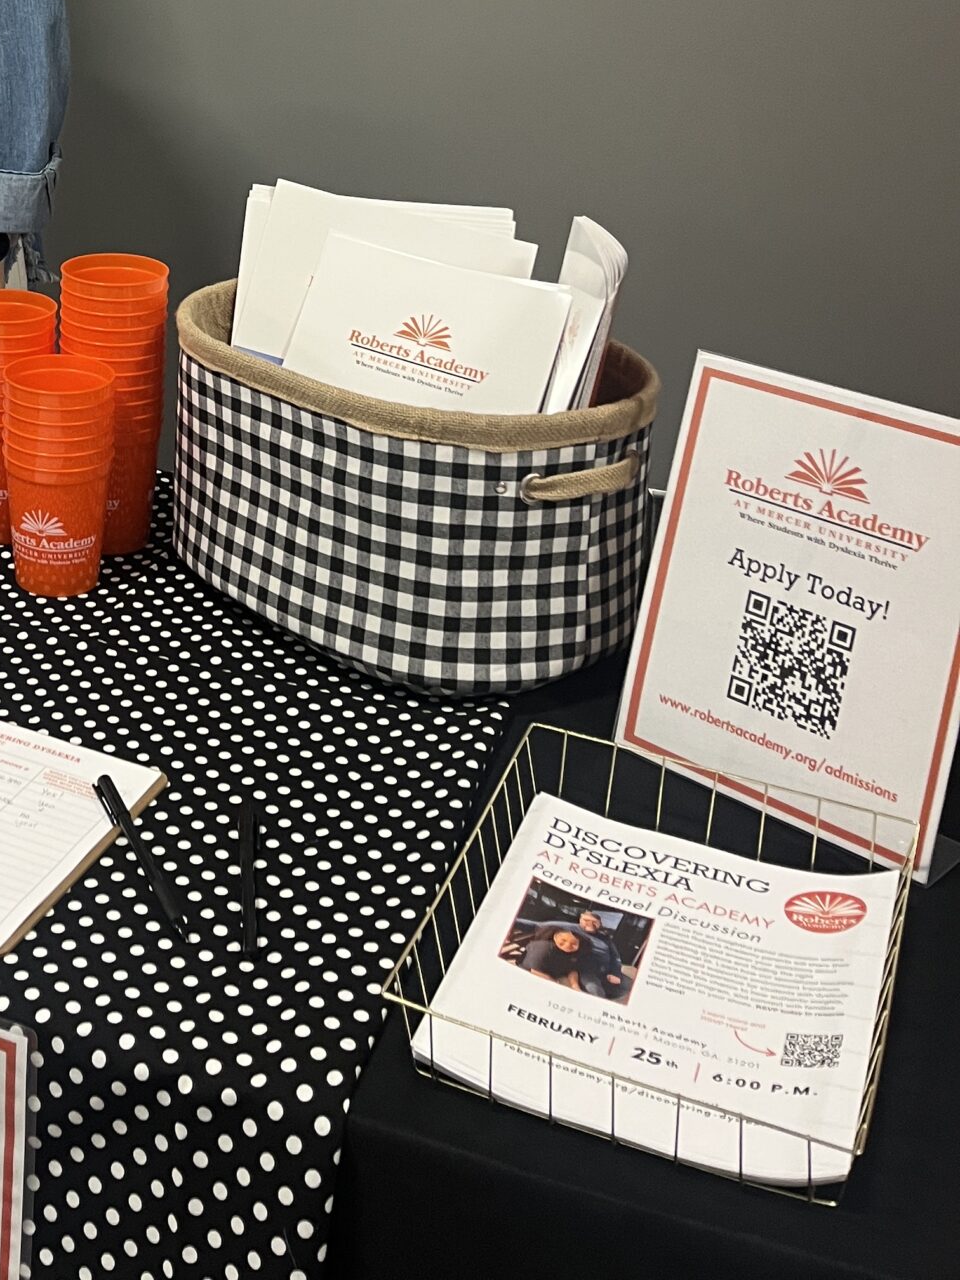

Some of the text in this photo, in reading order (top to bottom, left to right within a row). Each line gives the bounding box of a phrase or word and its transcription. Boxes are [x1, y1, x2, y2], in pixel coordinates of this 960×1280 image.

[348, 329, 490, 384] Roberts Academy
[352, 350, 473, 391] AT MERCER UNIVERSITY
[39, 534, 96, 550] Academy
[725, 469, 930, 553] Roberts Academy
[734, 499, 909, 563] AT MERCER UNIVERSITY
[739, 511, 898, 571] Where Students with Dyslexia Thrive
[728, 547, 890, 620] Apply Today!
[32, 742, 81, 764] DYSLEXIA
[658, 692, 899, 803] www.robertsacademy.org/admissions
[543, 831, 694, 892] DYSLEXIA
[550, 817, 771, 893] DISCOVERING
[531, 862, 762, 944] Parent Panel Discussion
[536, 849, 776, 930] AT ROBERTS ACADEMY
[792, 913, 857, 926] Roberts
[507, 1003, 601, 1045] FEBRUARY
[712, 1073, 761, 1091] 6:00
[771, 1083, 818, 1097] P.M.
[602, 1011, 648, 1030] Roberts
